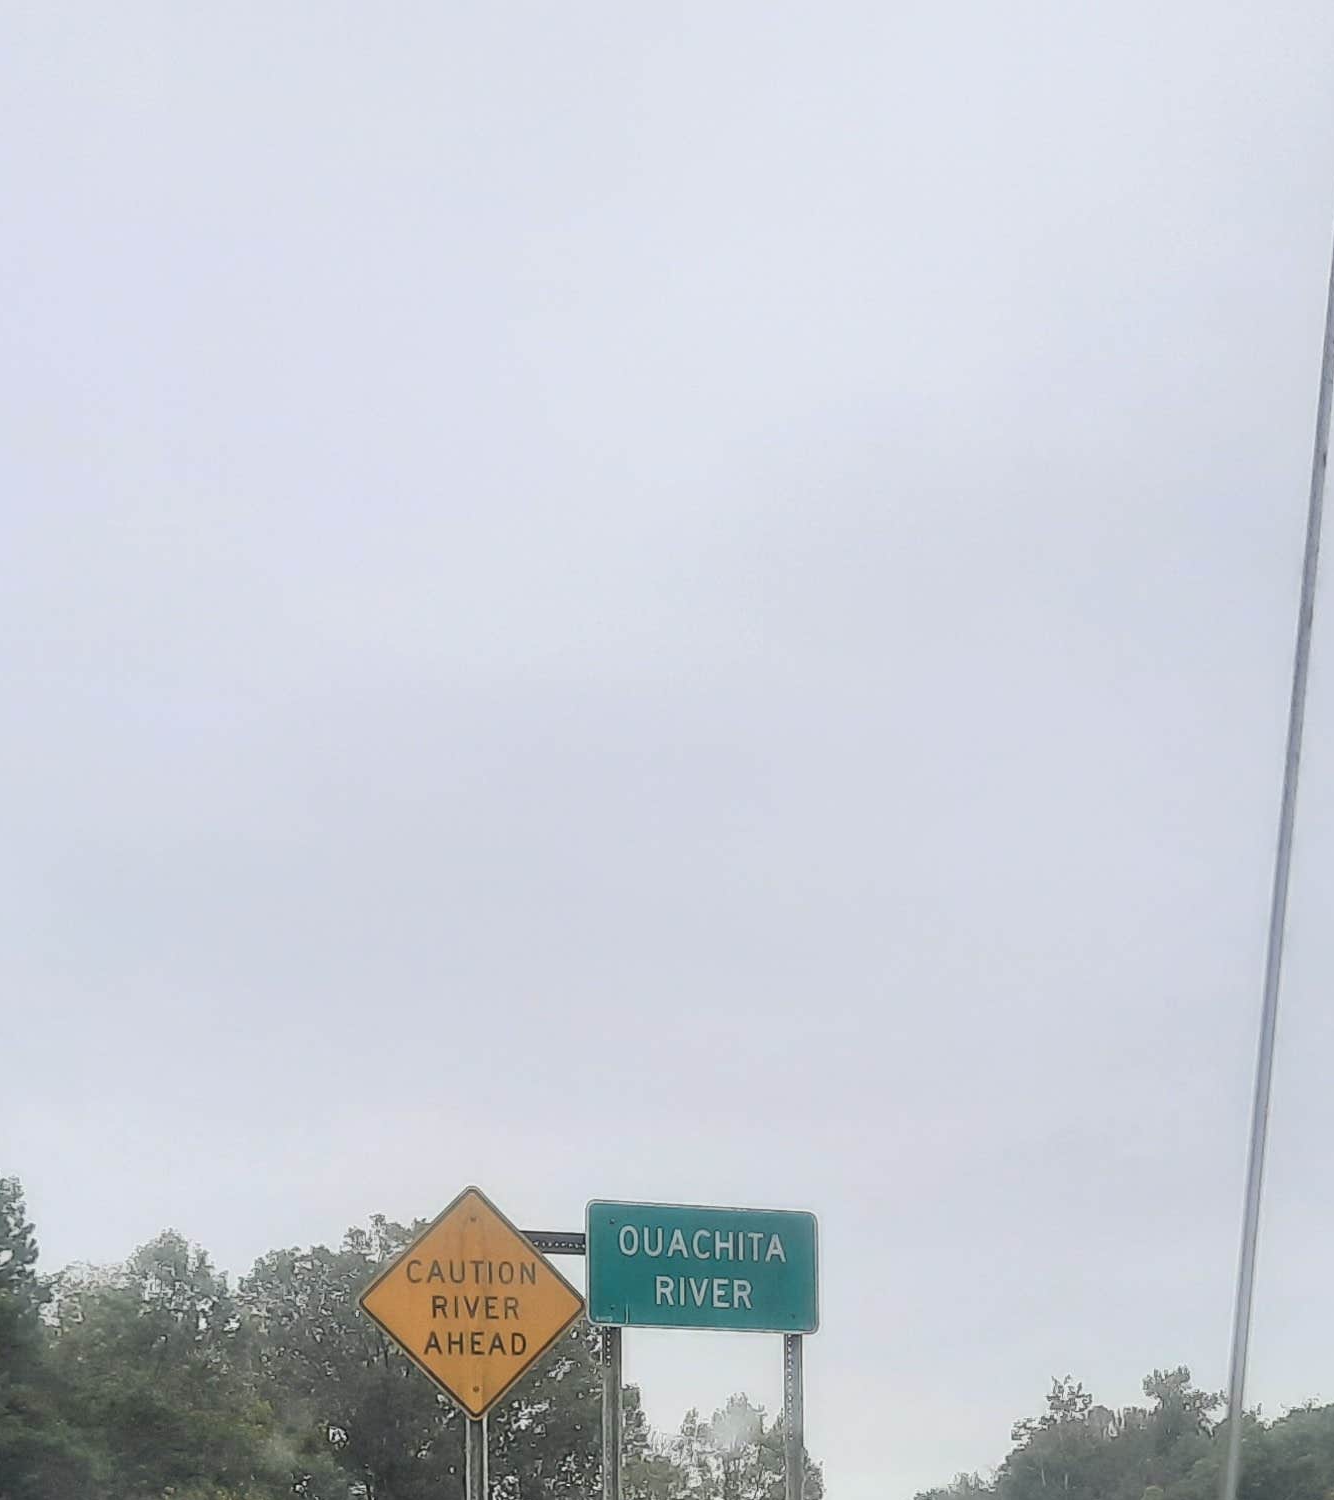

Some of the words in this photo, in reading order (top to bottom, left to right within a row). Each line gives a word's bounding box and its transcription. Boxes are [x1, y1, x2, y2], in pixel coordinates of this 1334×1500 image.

[619, 1225, 787, 1263] OUACHITA
[406, 1260, 536, 1285] CAUTION
[655, 1275, 752, 1310] RIVER
[432, 1295, 519, 1320] RIVER
[424, 1331, 527, 1356] AHEAD
